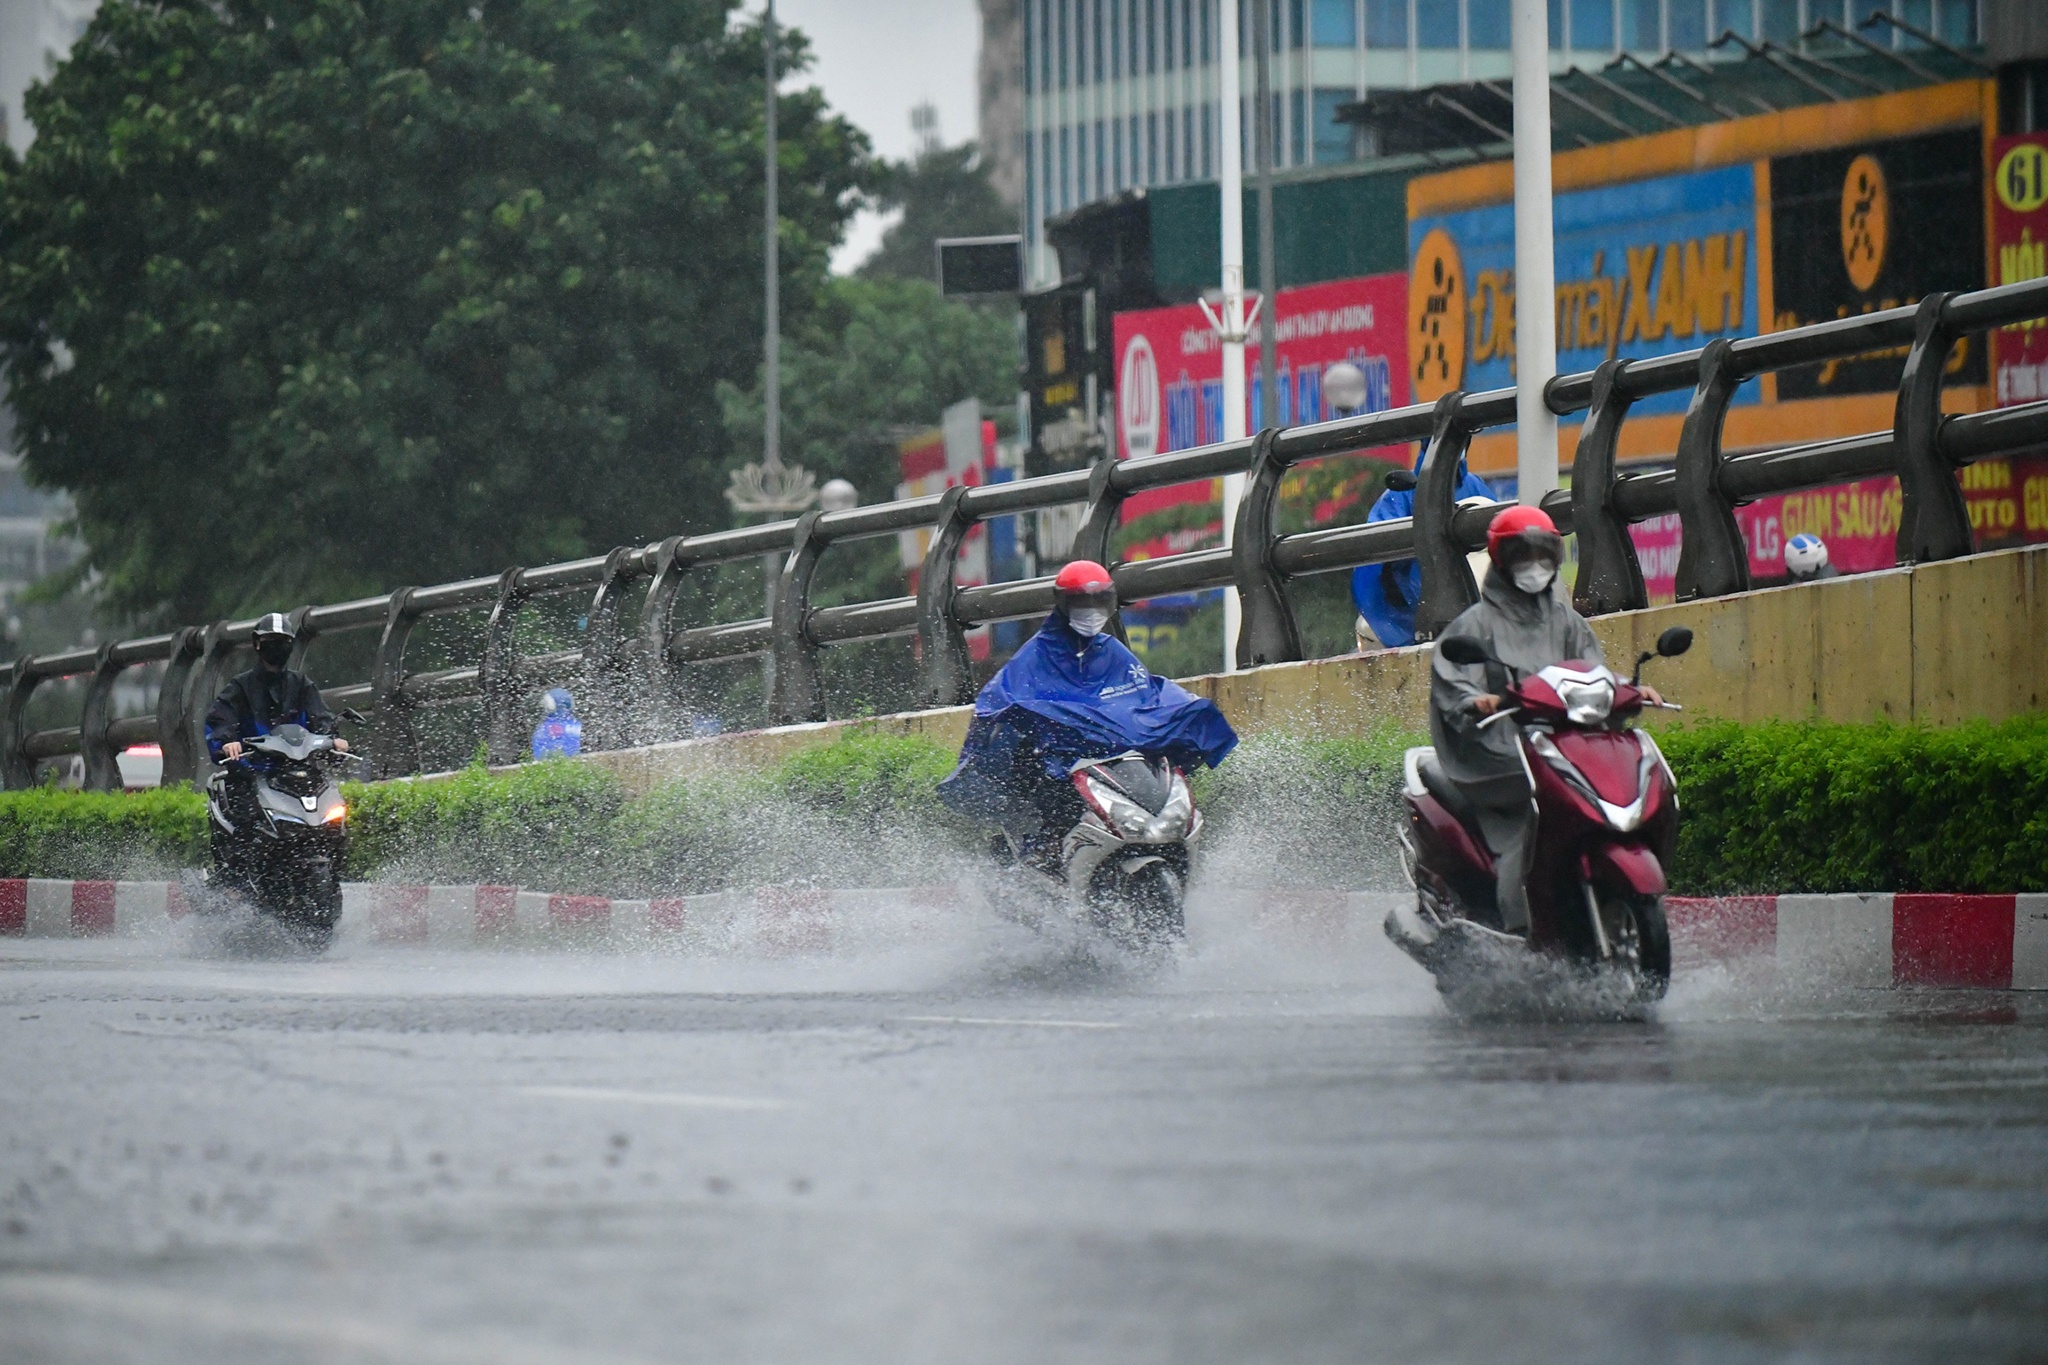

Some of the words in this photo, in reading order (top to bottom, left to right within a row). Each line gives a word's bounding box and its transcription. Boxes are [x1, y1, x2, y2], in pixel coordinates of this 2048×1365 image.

[2006, 153, 2044, 203] 61
[1622, 230, 1747, 342] XANH
[1966, 497, 2017, 530] UTO
[1754, 515, 1779, 560] LG
